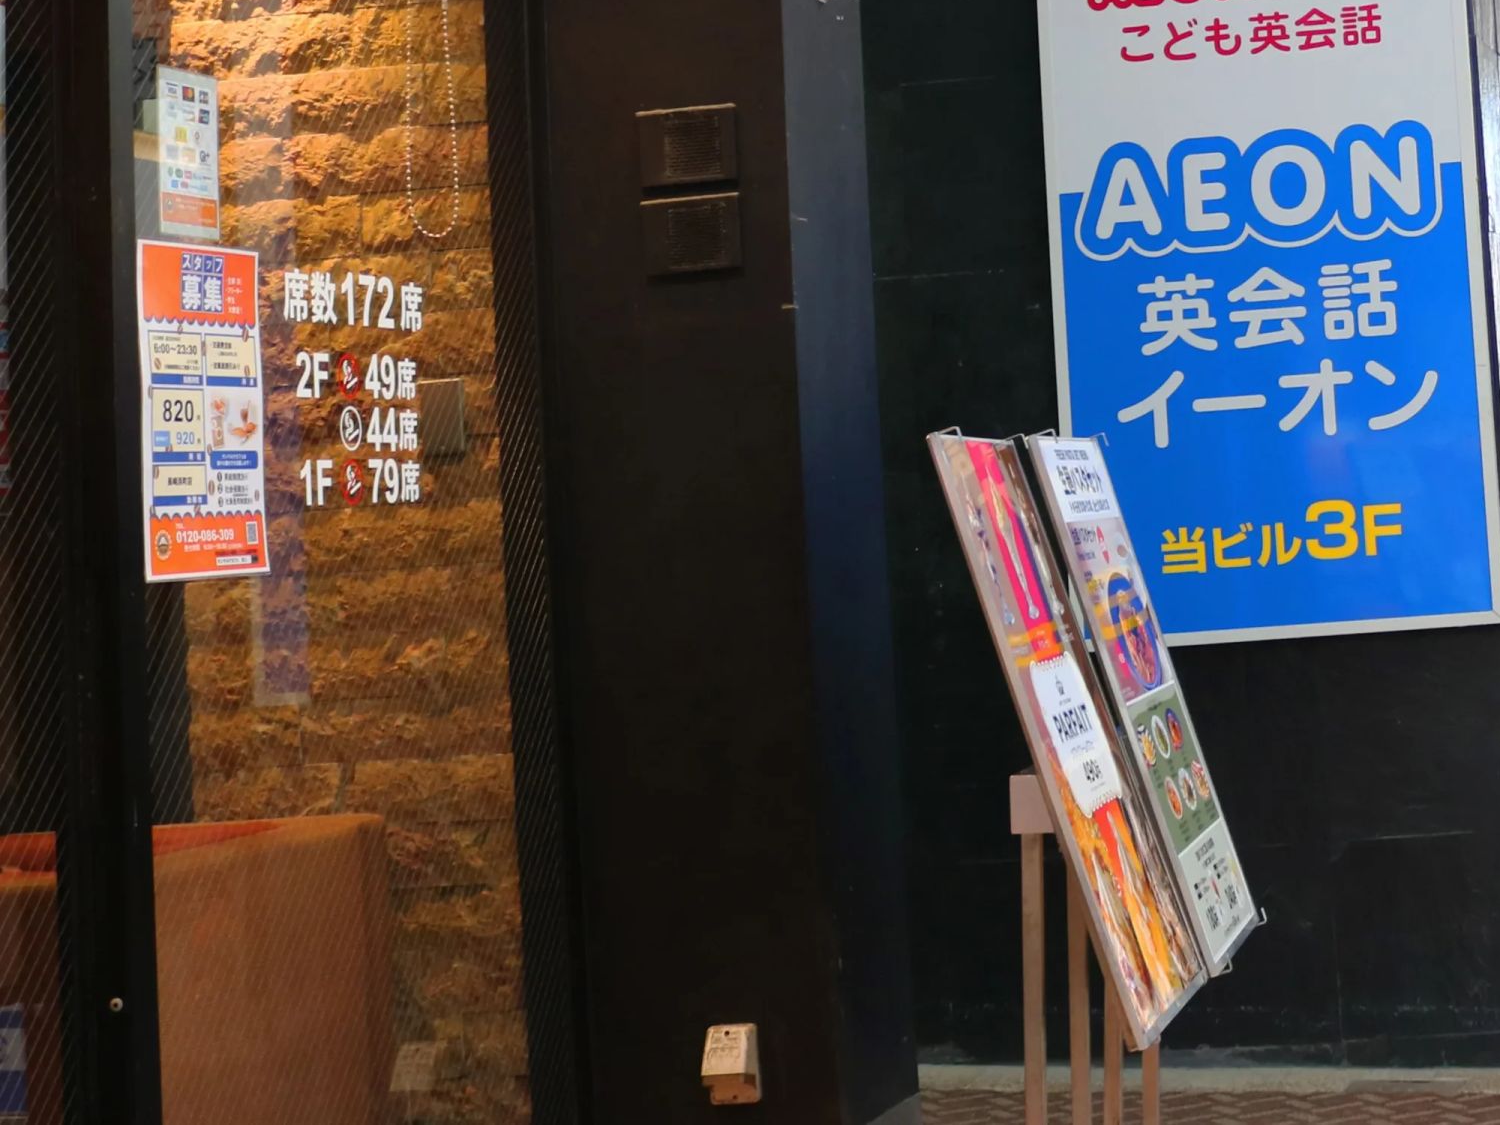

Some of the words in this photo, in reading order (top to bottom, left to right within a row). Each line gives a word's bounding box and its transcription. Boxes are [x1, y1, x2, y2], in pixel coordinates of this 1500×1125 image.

[1119, 3, 1382, 63] こども英会話
[1088, 128, 1430, 247] AEON
[182, 254, 224, 273] スタッフ
[182, 274, 223, 311] 募集
[1136, 257, 1398, 357] 英会話
[295, 350, 330, 399] 2F
[364, 353, 417, 401] 49席
[366, 406, 418, 453] 44席
[1117, 359, 1439, 449] イーオン
[299, 459, 334, 506] 1F
[368, 458, 420, 504] 79席
[1160, 499, 1404, 574] 当ビル3F
[1052, 703, 1092, 744] PARFAIT
